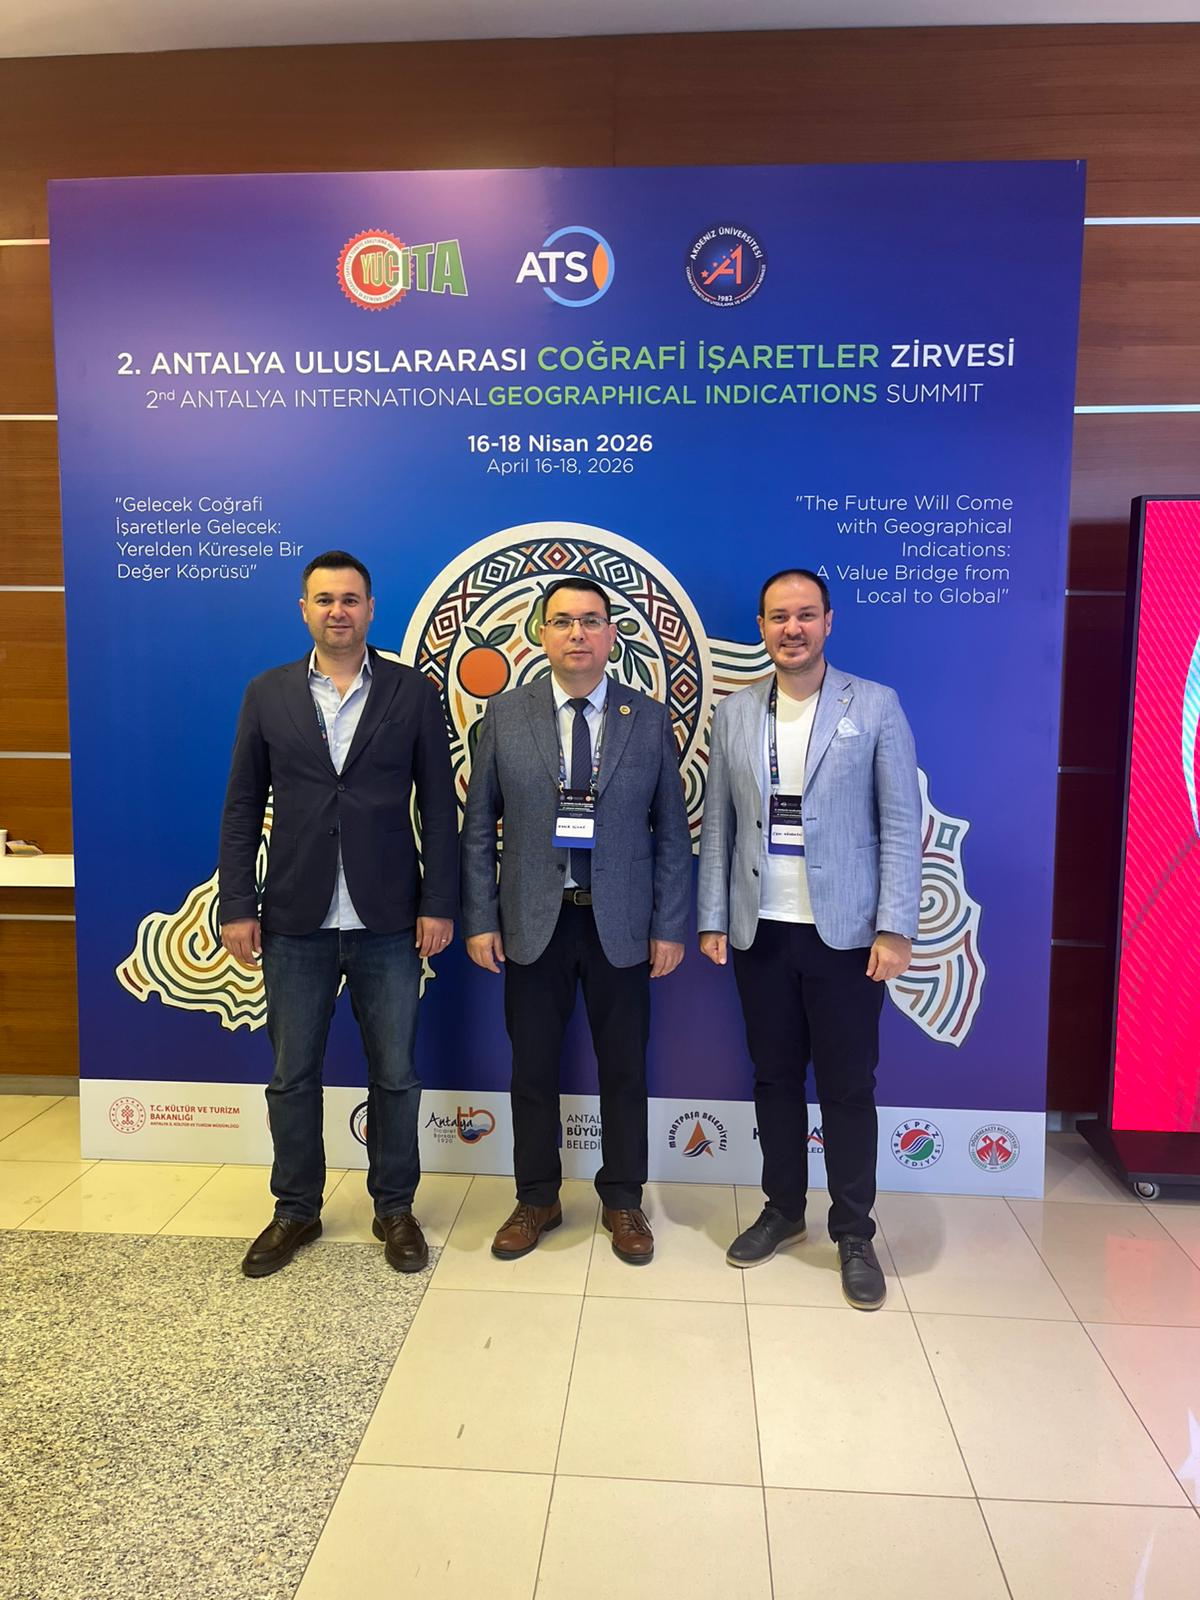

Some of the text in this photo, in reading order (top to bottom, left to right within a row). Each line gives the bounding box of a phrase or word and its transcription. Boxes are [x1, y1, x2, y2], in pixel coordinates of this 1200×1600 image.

[690, 227, 763, 260] AKDENİZ ÜNİVERSİTESİ
[515, 251, 588, 283] ATS
[118, 337, 1015, 375] 2. ANTALYA ULUSLARARASI COĞRAFİ İŞARETLER ZİRVESİ
[146, 383, 984, 409] 2nd ANTALYA INTERNATIONAL GEOGRAPHICAL INDICATIONS SUMMIT
[467, 433, 653, 453] 16-18 Nisan 2026
[486, 457, 634, 477] April 16-18, 2026
[115, 495, 263, 515] "Gelecek Coğrafi
[795, 494, 1014, 511] "The Future Will Come
[116, 516, 281, 537] İşaretlerle Gelecek:
[836, 517, 1012, 538] with Geographical
[116, 541, 304, 557] Yerelden Küresele Bir
[902, 540, 1011, 558] Indications:
[117, 563, 257, 582] Değer Köprüsü"
[816, 564, 1010, 584] A Value Bridge from
[856, 587, 1009, 604] Local to Global"
[150, 1113, 193, 1121] BAKANLIĞI
[165, 1104, 196, 1113] KÜLTÜR
[197, 1106, 208, 1114] VE
[209, 1106, 240, 1114] TURİZM
[567, 1114, 601, 1123] ANTAL
[425, 1111, 475, 1130] Antalya
[895, 1121, 939, 1139] KEPEZ
[567, 1125, 602, 1137] BÜYÜ
[668, 1111, 728, 1151] MURATPAŞA BELEDİYESİ
[567, 1139, 600, 1150] BELEDİ
[893, 1142, 942, 1167] BELEDİYESİ
